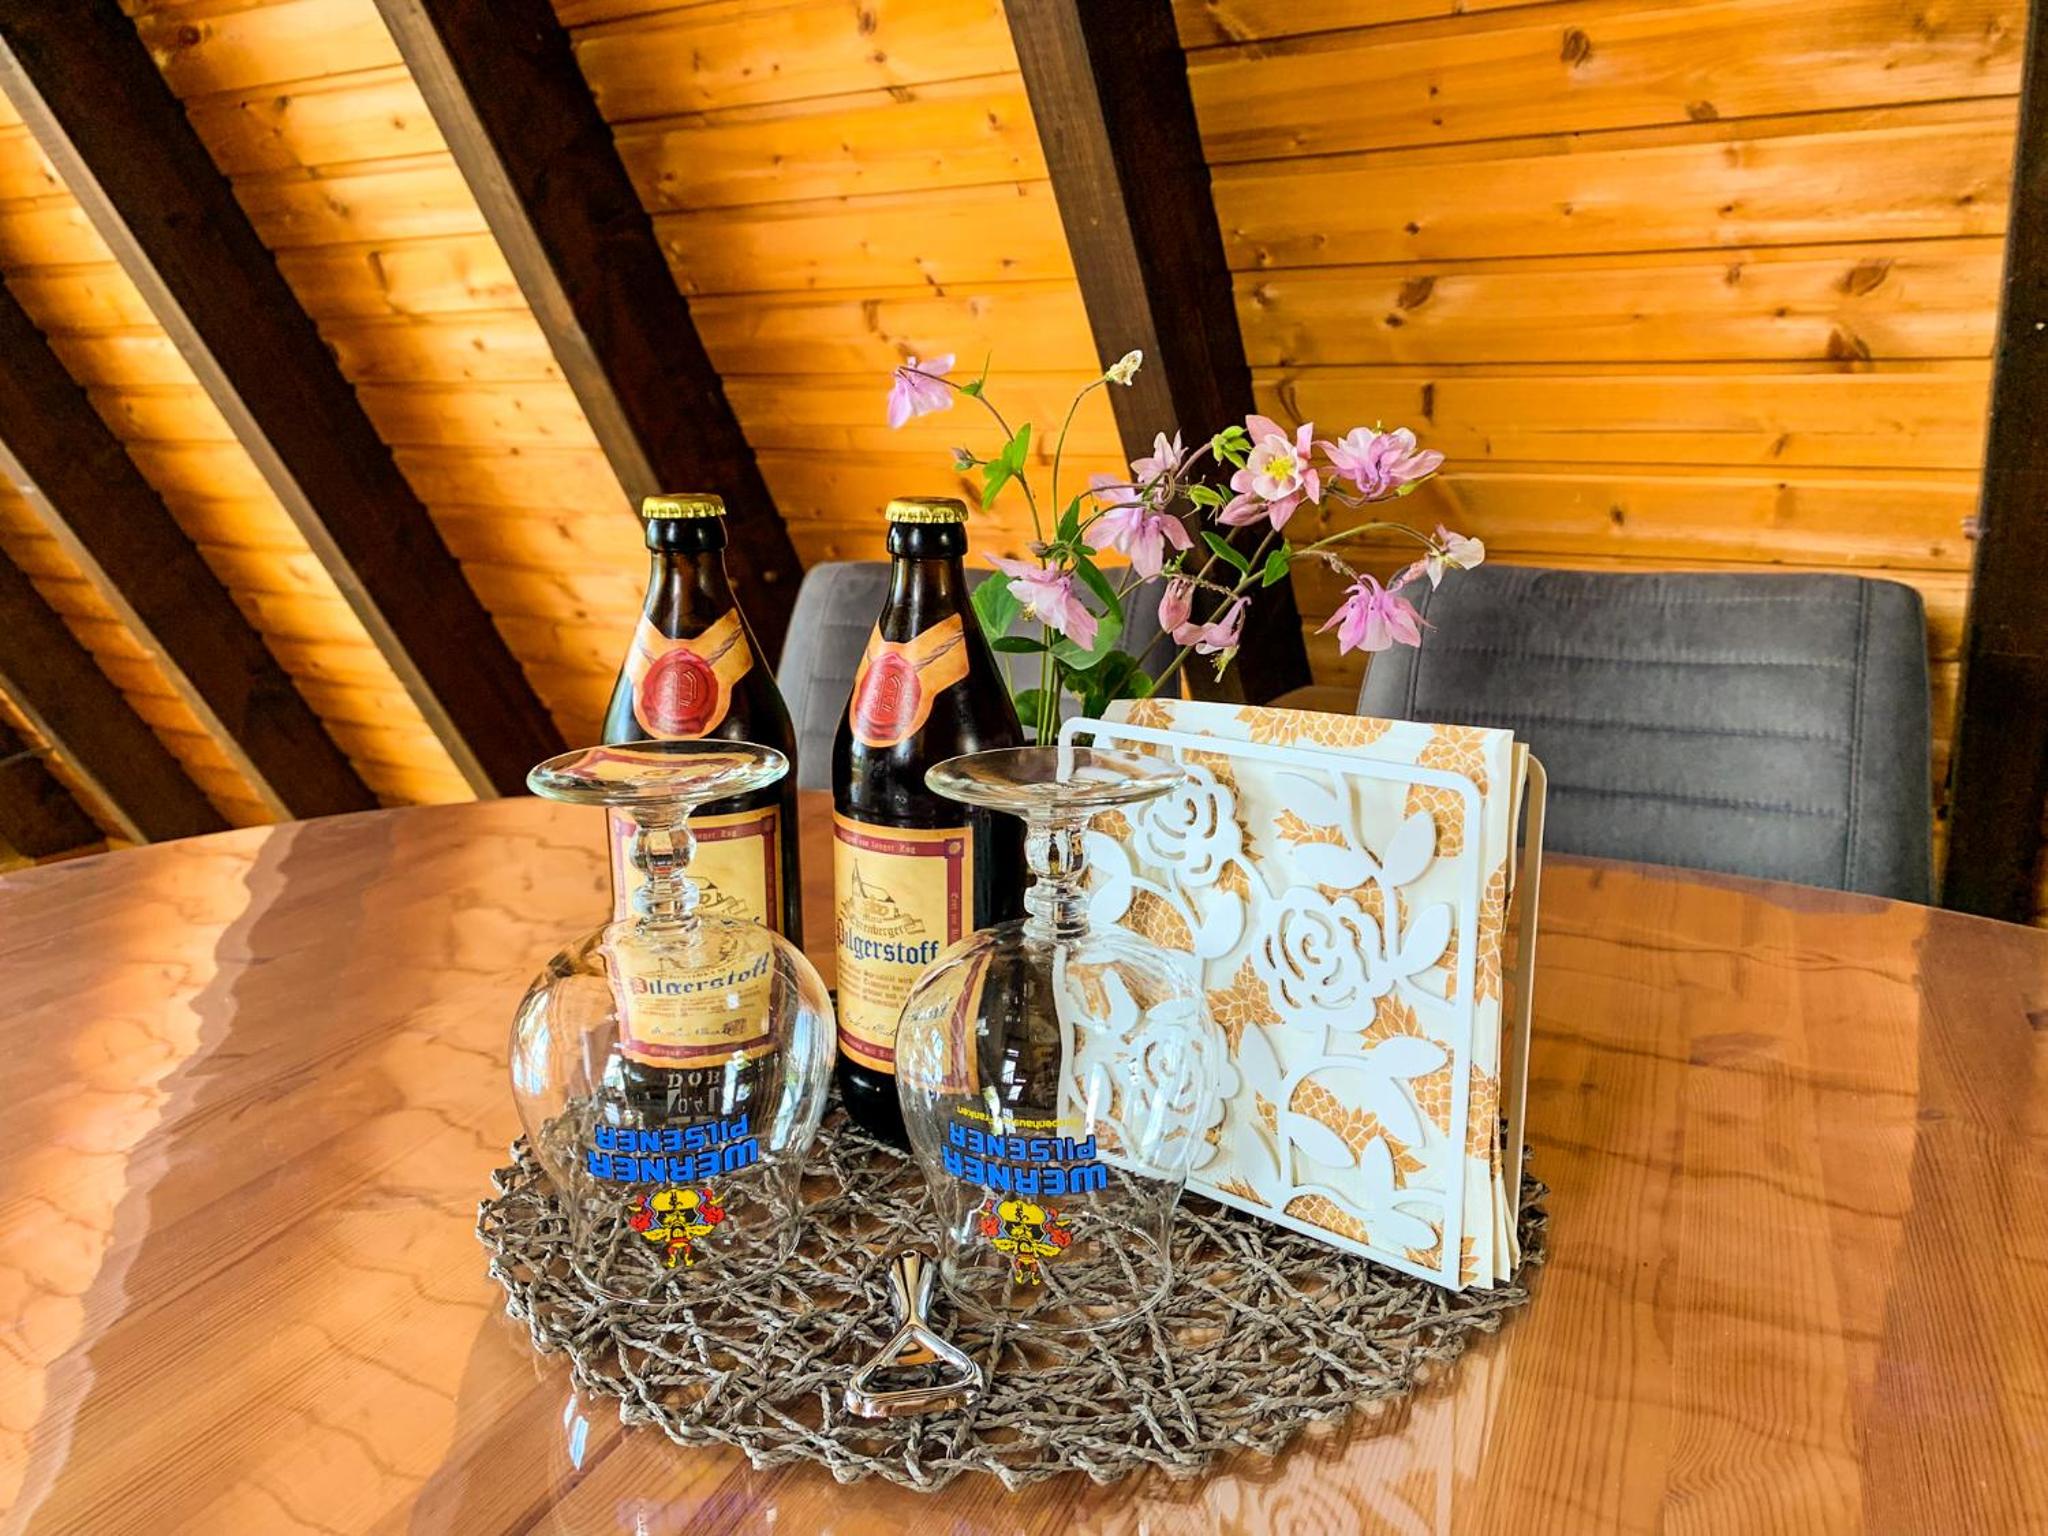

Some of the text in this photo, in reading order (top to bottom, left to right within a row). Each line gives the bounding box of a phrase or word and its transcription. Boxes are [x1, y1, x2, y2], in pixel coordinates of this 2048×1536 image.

[593, 1112, 750, 1152] PILSENER
[948, 1120, 1097, 1163] PILSENER
[585, 1137, 760, 1185] WERNER
[940, 1143, 1109, 1198] WERNER
